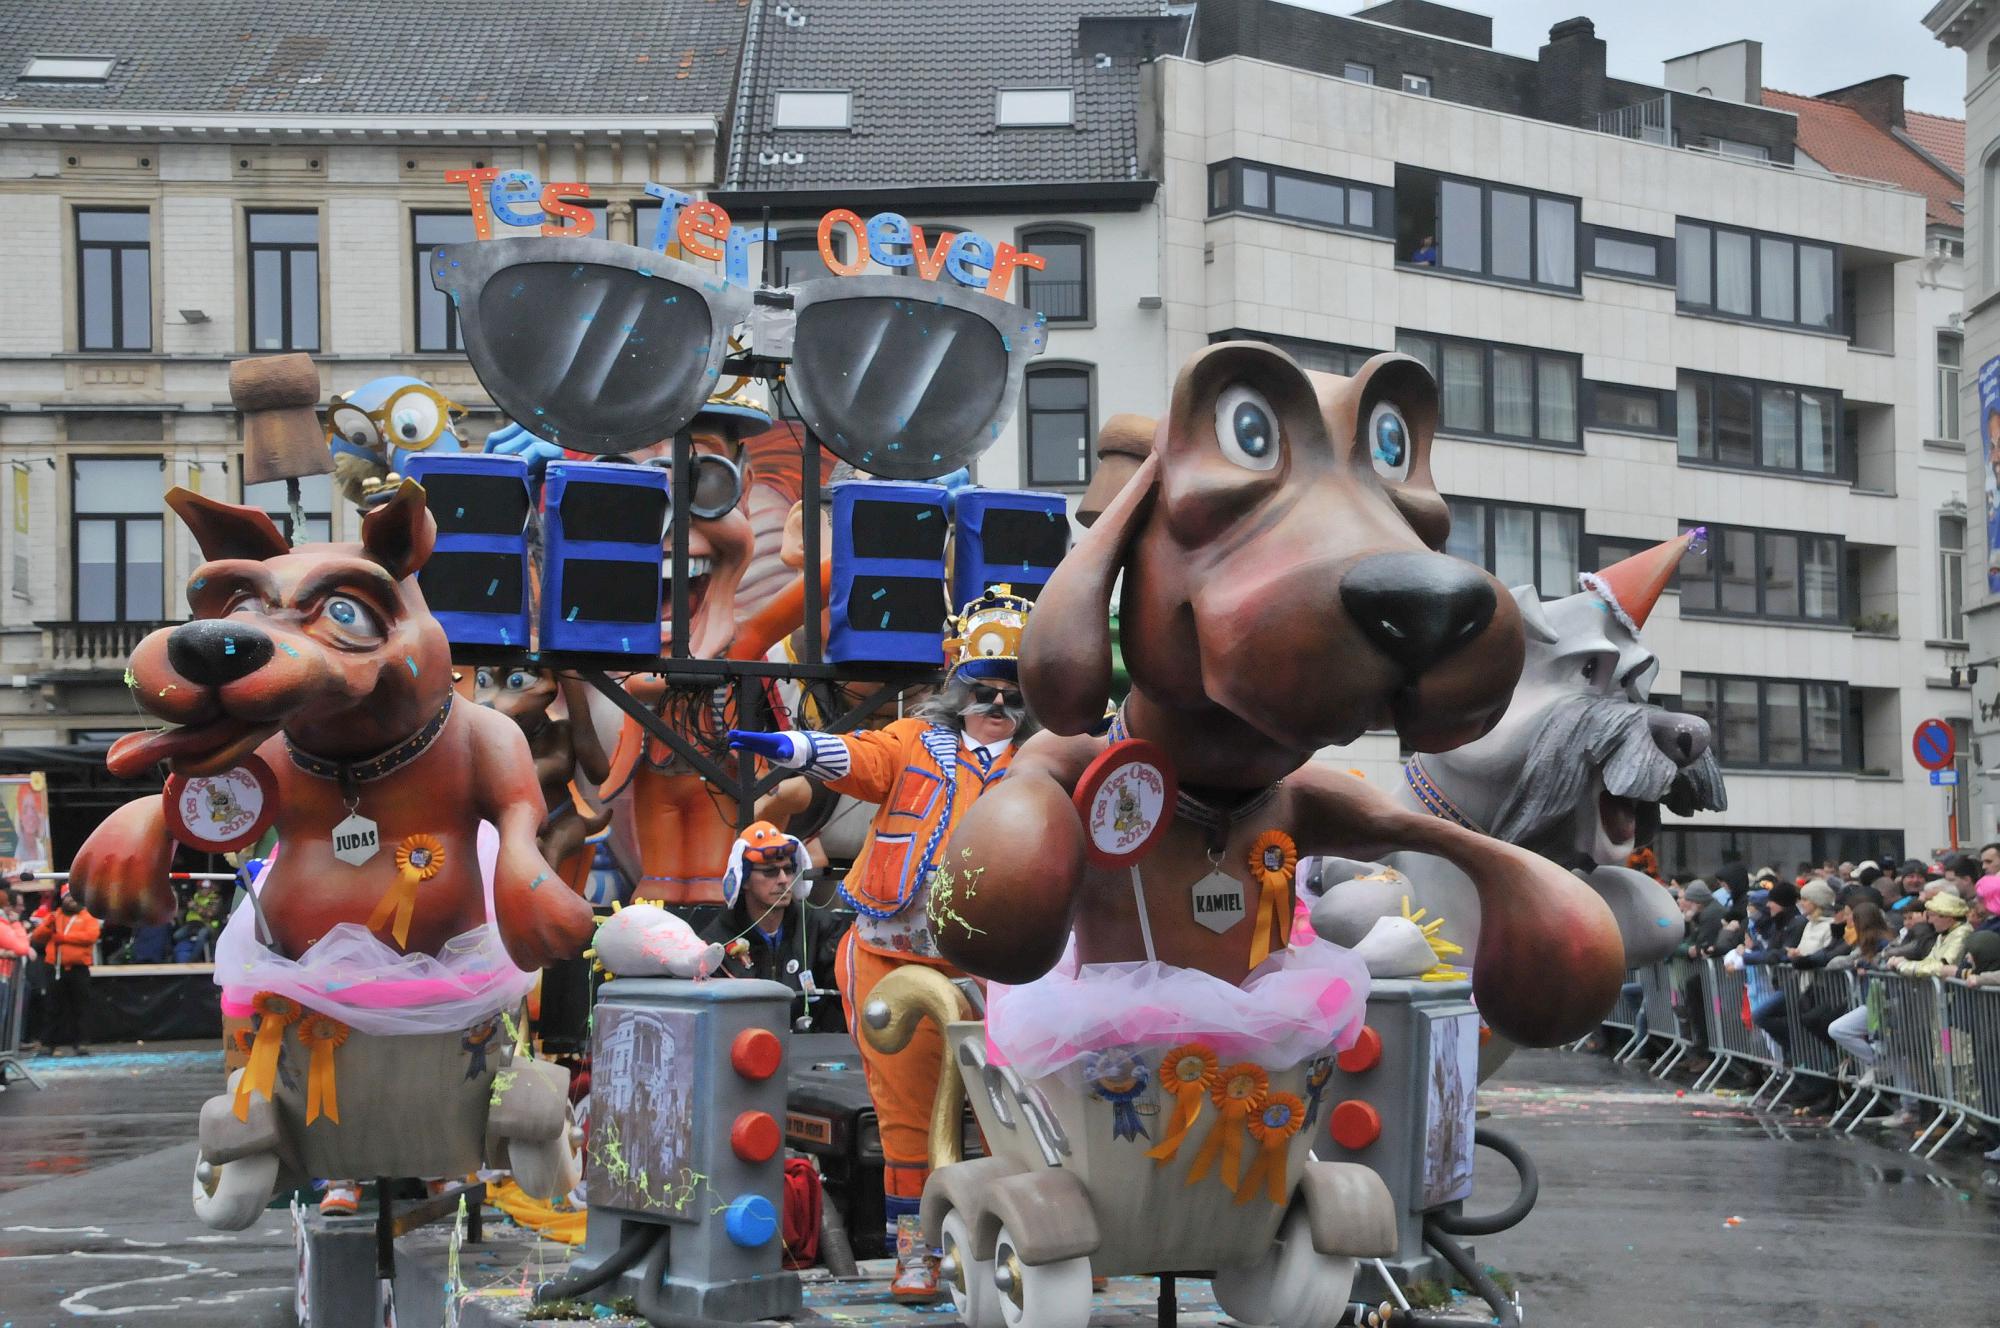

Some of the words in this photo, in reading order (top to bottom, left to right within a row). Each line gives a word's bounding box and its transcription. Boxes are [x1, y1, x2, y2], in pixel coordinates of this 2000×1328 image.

[445, 168, 596, 241] Tes
[644, 181, 778, 288] Ter
[818, 208, 1047, 300] Oever
[1091, 799, 1107, 834] Tes
[1101, 771, 1129, 797] Ter
[1130, 764, 1162, 795] Oever
[219, 810, 255, 836] 2019
[1116, 819, 1151, 849] 2019
[335, 830, 377, 852] JUDAS
[1195, 893, 1243, 913] KAMIEL
